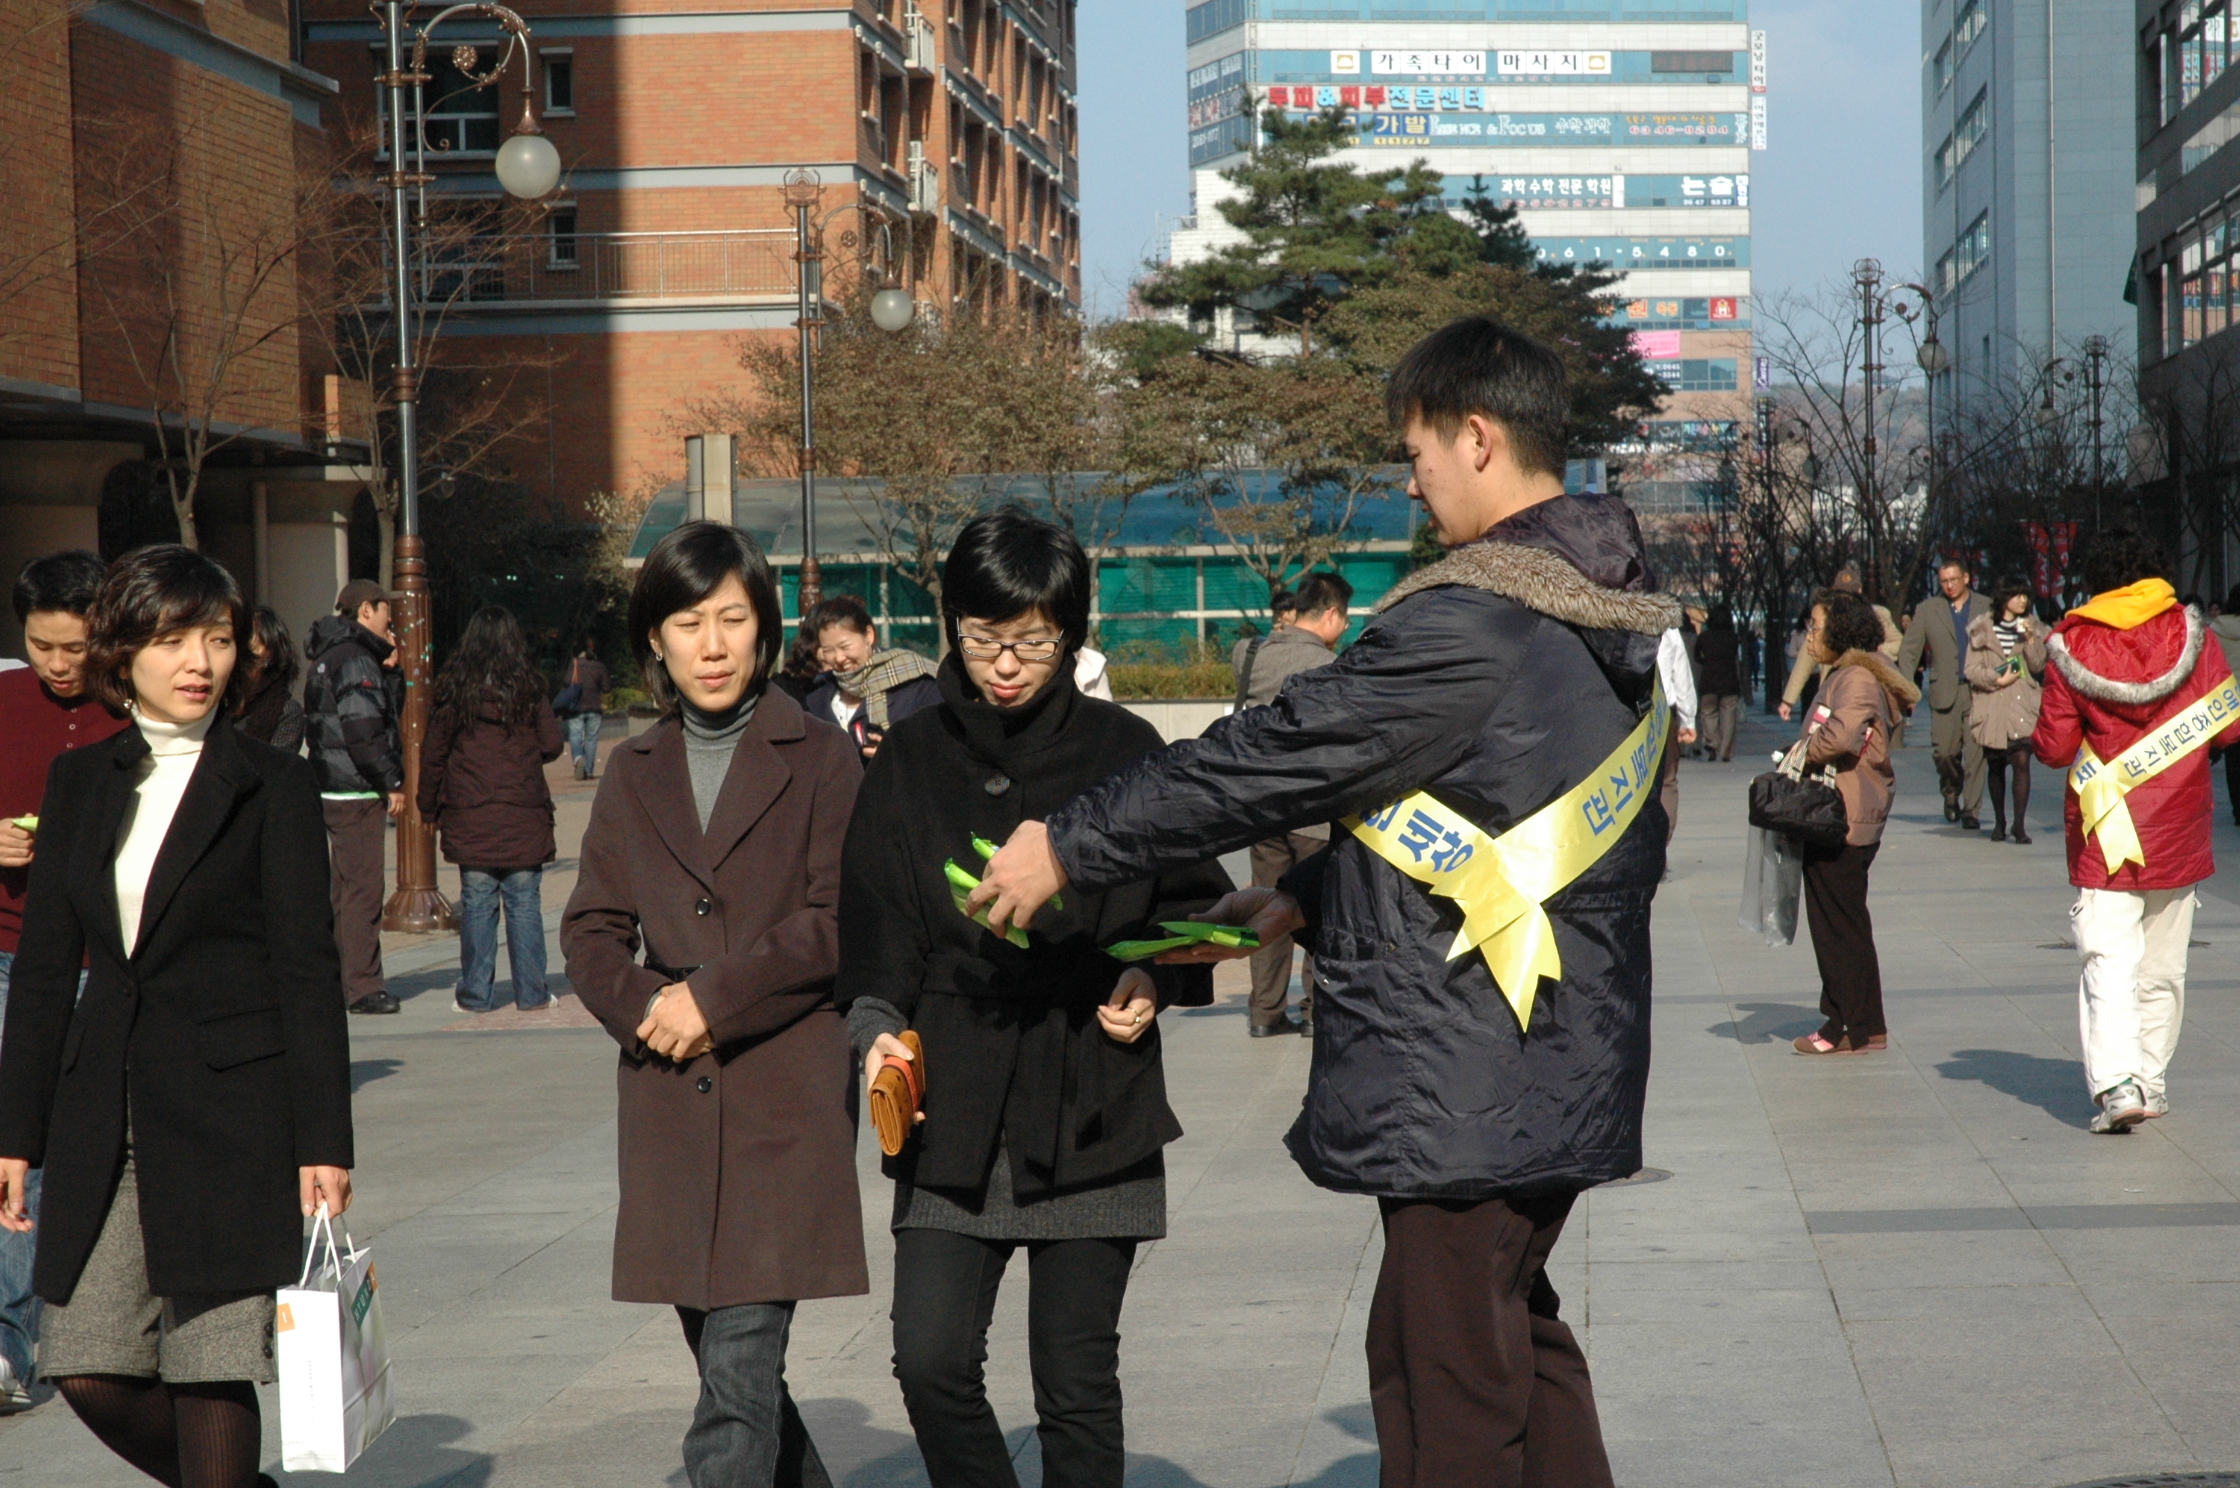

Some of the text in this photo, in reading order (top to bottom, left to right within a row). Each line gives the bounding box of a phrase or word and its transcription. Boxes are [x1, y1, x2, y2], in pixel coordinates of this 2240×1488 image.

[1377, 54, 1577, 70] 가족타이 마사지
[1376, 115, 1427, 134] 가발
[1501, 178, 1526, 195] 과학
[1529, 178, 1554, 195] 수학
[1558, 178, 1582, 195] 전문
[1586, 178, 1611, 195] 학원
[1681, 176, 1734, 196] 논술
[2123, 685, 2240, 778] 애인종합복지관
[1397, 809, 1474, 873] 세상
